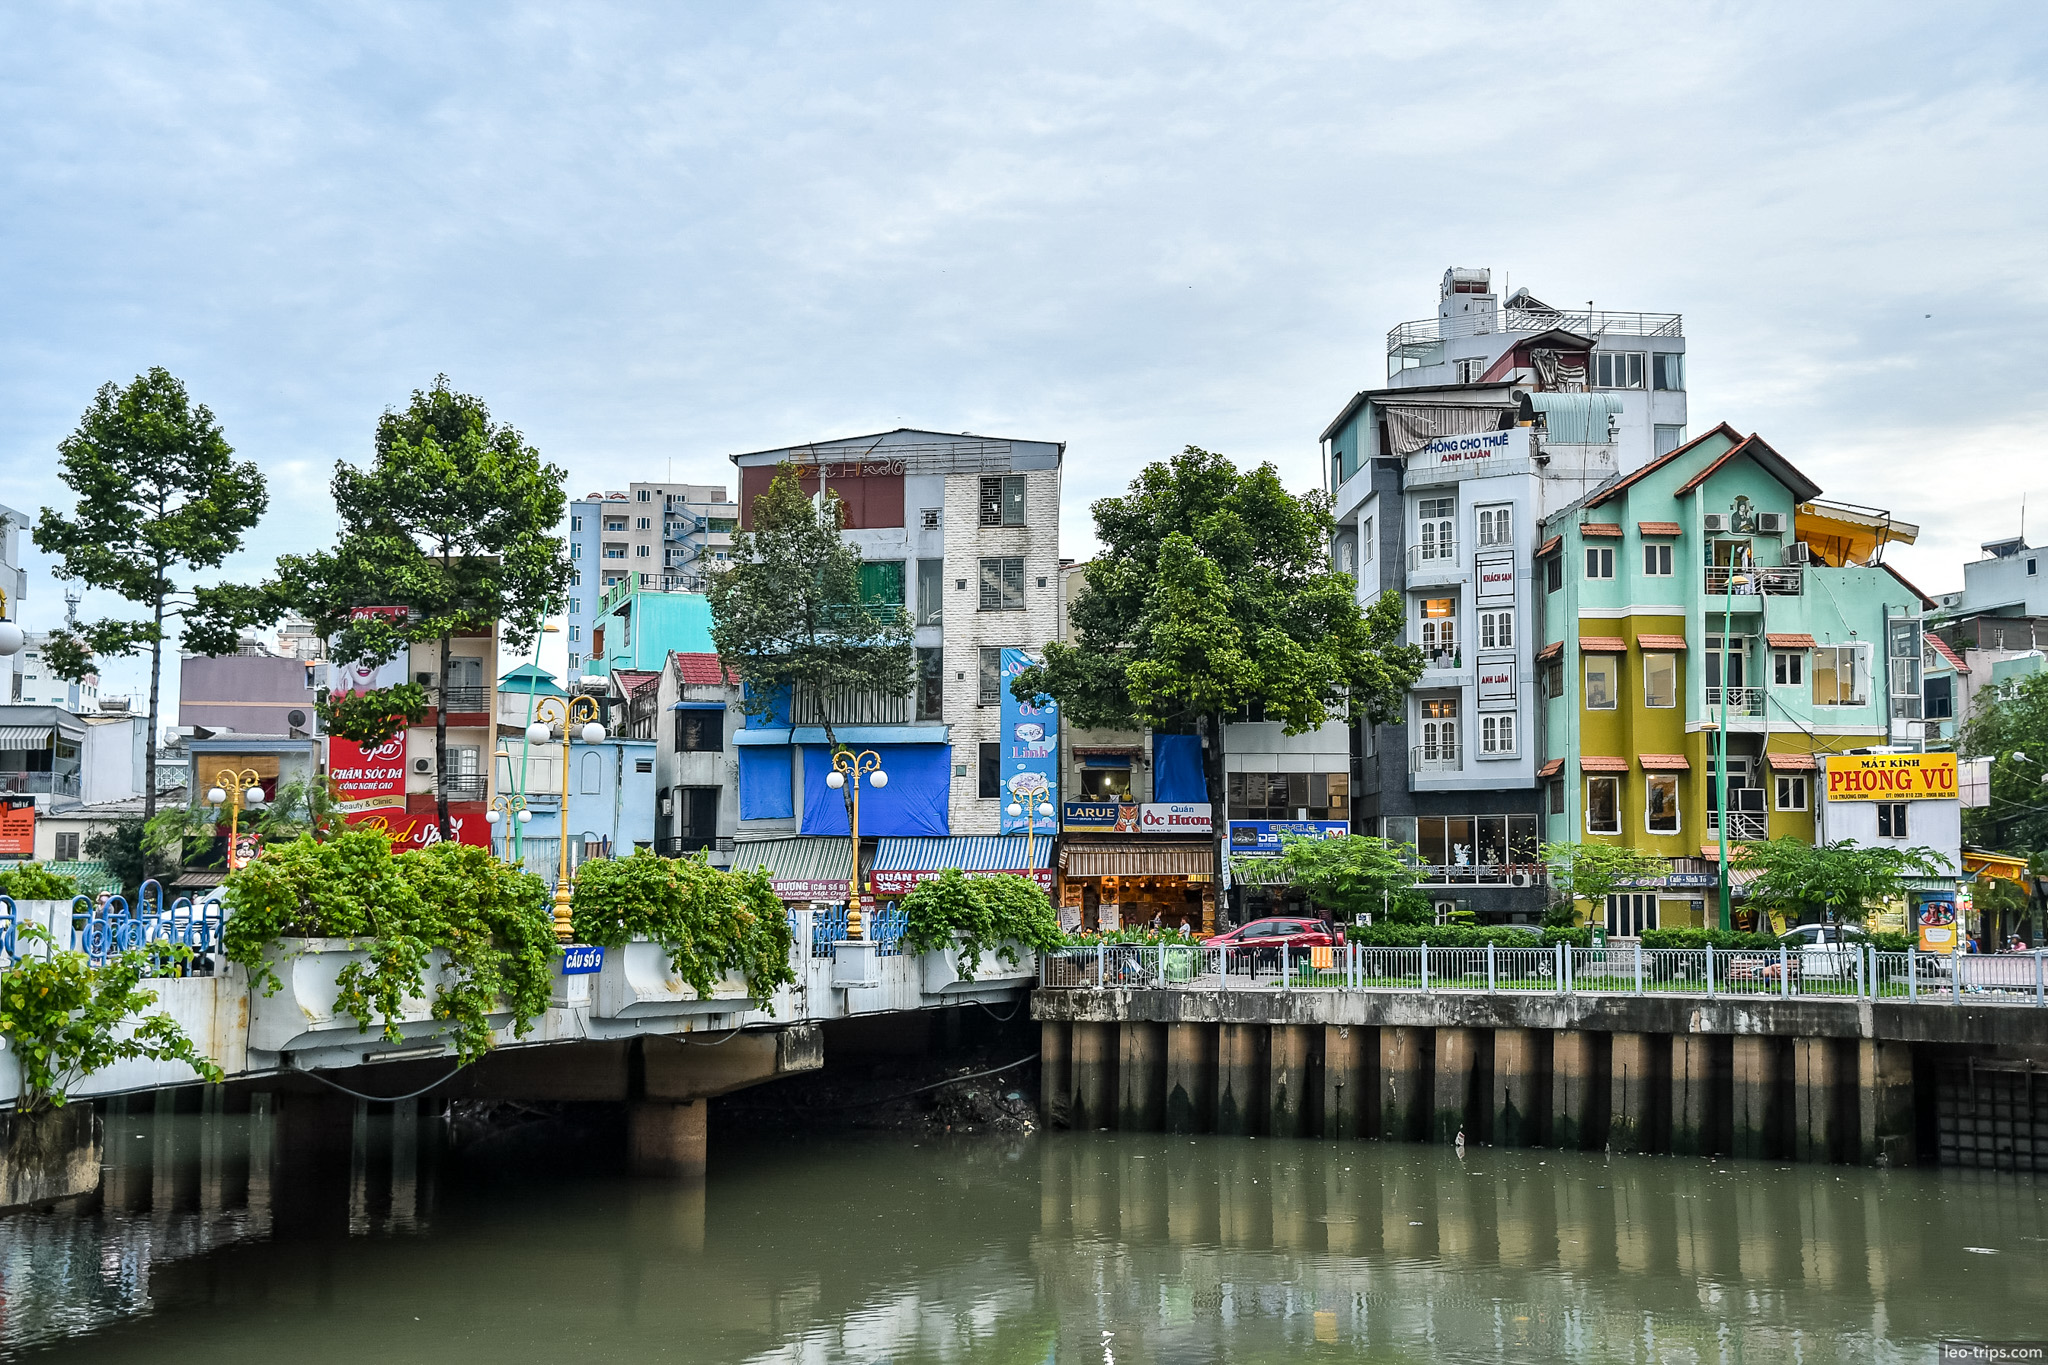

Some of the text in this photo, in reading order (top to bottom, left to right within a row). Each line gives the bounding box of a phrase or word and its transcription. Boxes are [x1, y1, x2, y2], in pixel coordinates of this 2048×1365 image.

[1424, 432, 1508, 454] PHÒNG CHO THUÊ
[1441, 453, 1462, 462] ANH
[1483, 572, 1501, 582] KHÁCH
[1012, 746, 1049, 758] Linh
[364, 766, 386, 779] SÓC
[387, 768, 403, 779] DA
[1829, 769, 1912, 791] PHONG
[1920, 763, 1953, 789] VŨ
[339, 803, 363, 811] Beauty
[372, 798, 393, 806] Clinic
[1171, 805, 1194, 813] Quán
[1066, 808, 1115, 817] LARUE
[1167, 815, 1211, 828] Hươn
[413, 824, 455, 850] Sp
[876, 872, 912, 882] QUÁN
[839, 883, 847, 891] 9)
[583, 949, 596, 967] SỐ
[595, 954, 601, 967] 9
